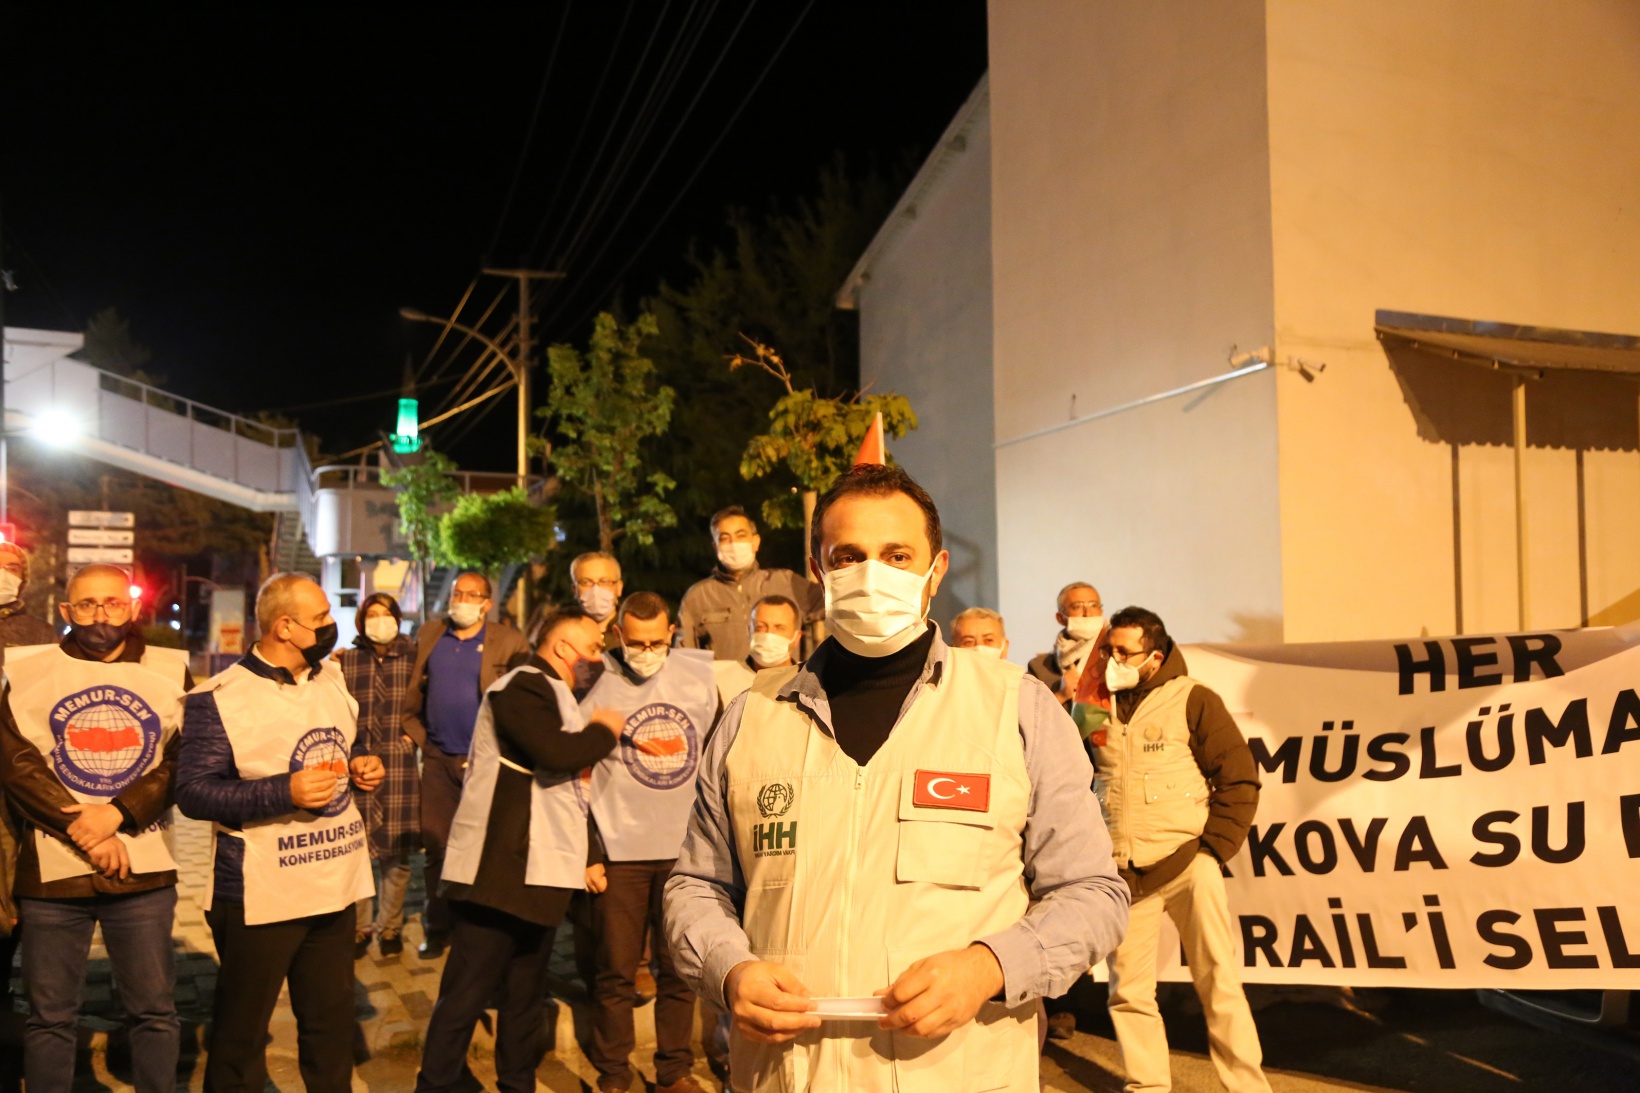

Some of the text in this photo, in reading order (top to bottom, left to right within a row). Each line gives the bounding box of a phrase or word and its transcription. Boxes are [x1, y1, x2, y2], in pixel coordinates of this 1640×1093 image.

[1394, 634, 1565, 695] HER
[54, 689, 152, 722] MEMUR-SEN
[623, 706, 690, 737] MEMUR-SEN
[1248, 817, 1450, 877] KOVA
[1469, 801, 1586, 868] SU
